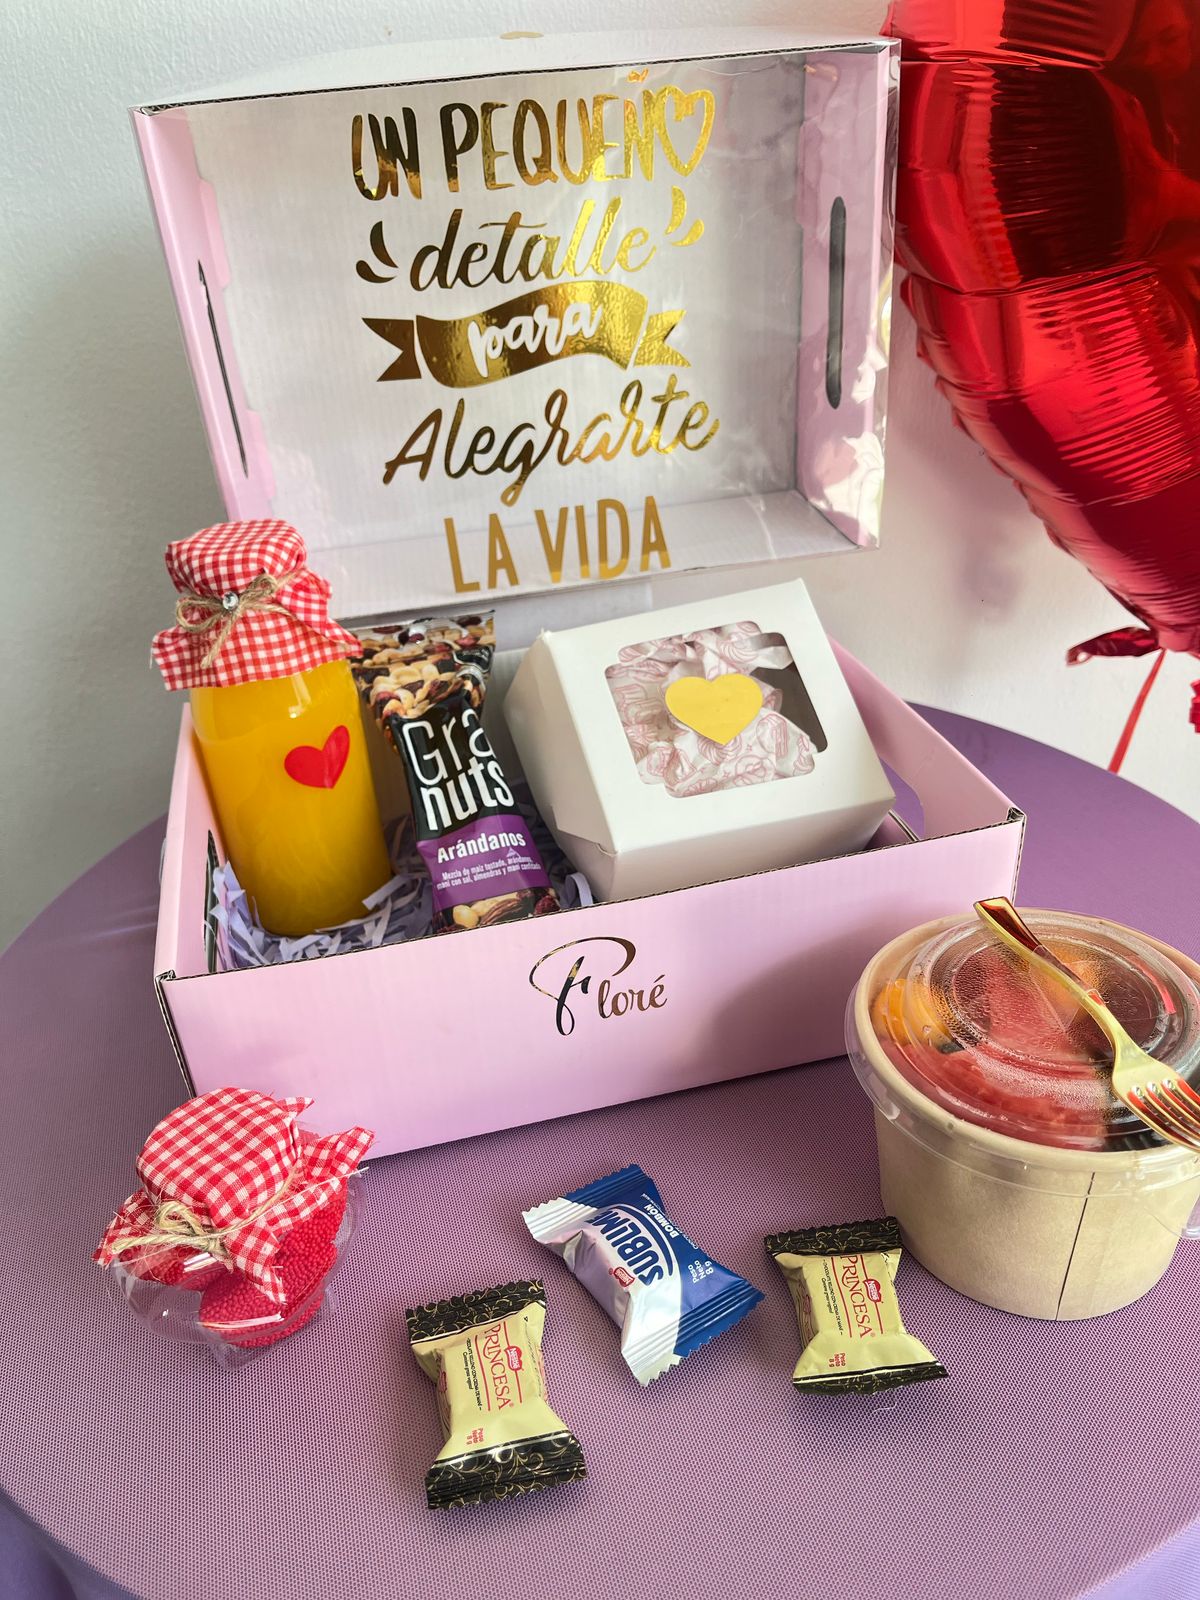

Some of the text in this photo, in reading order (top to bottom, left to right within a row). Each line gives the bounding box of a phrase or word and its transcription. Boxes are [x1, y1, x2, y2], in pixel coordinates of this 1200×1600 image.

[351, 106, 422, 200] UN
[409, 197, 656, 292] detalle
[467, 302, 603, 378] para
[382, 373, 720, 507] Alegrarte
[444, 495, 672, 593] LA VIDA
[402, 708, 497, 785] Gra
[420, 756, 515, 831] nuts
[437, 831, 527, 864] Arándanos
[441, 868, 462, 881] Mezcla
[462, 867, 469, 875] de
[529, 936, 668, 1036] Floré
[644, 1204, 679, 1238] BOMBÓN
[688, 1265, 698, 1284] Peso
[694, 1260, 706, 1280] Neto
[840, 1255, 873, 1338] PRINCESA
[483, 1324, 513, 1411] PRINCESA
[839, 1352, 847, 1366] Peso
